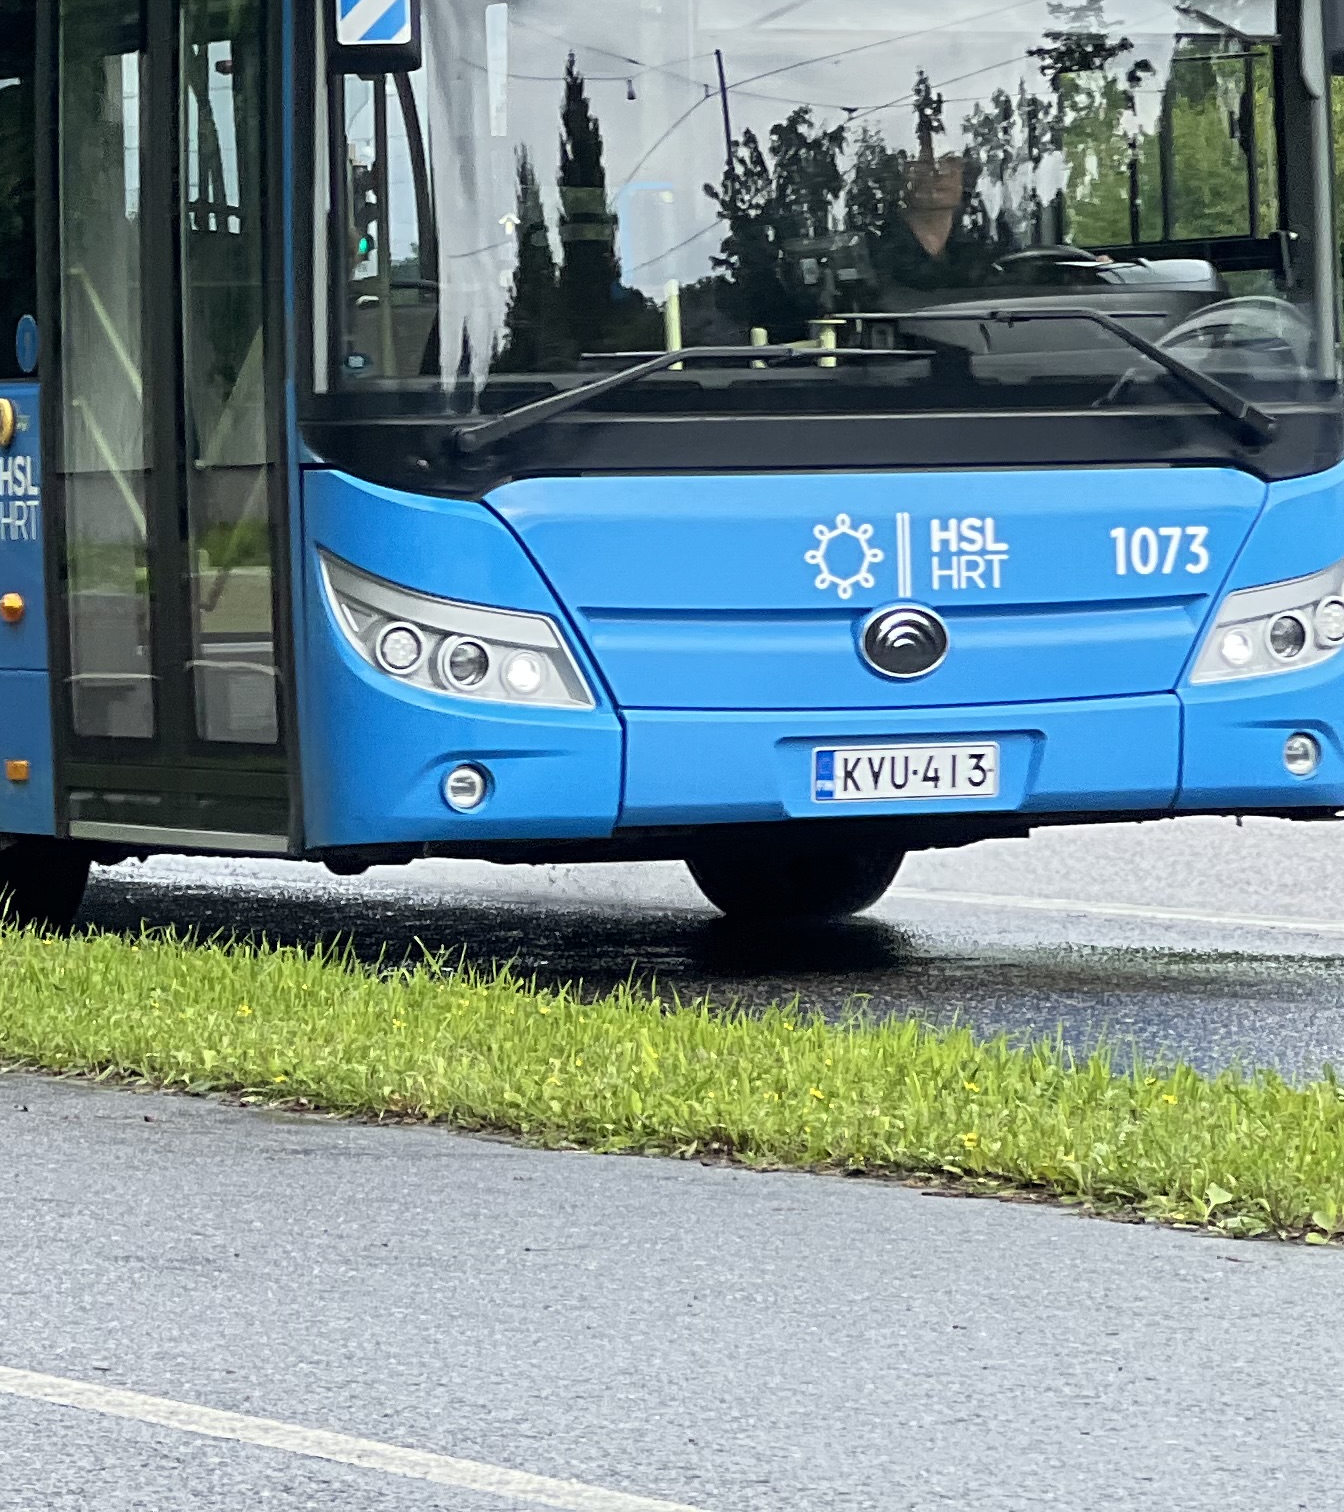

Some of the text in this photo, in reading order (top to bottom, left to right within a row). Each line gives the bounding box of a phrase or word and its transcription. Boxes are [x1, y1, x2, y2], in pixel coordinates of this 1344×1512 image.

[0, 500, 40, 541] HRT
[930, 517, 1009, 553] HSL
[1109, 526, 1209, 576] 1073
[931, 554, 1009, 590] HRT
[843, 753, 988, 792] KVU-413
